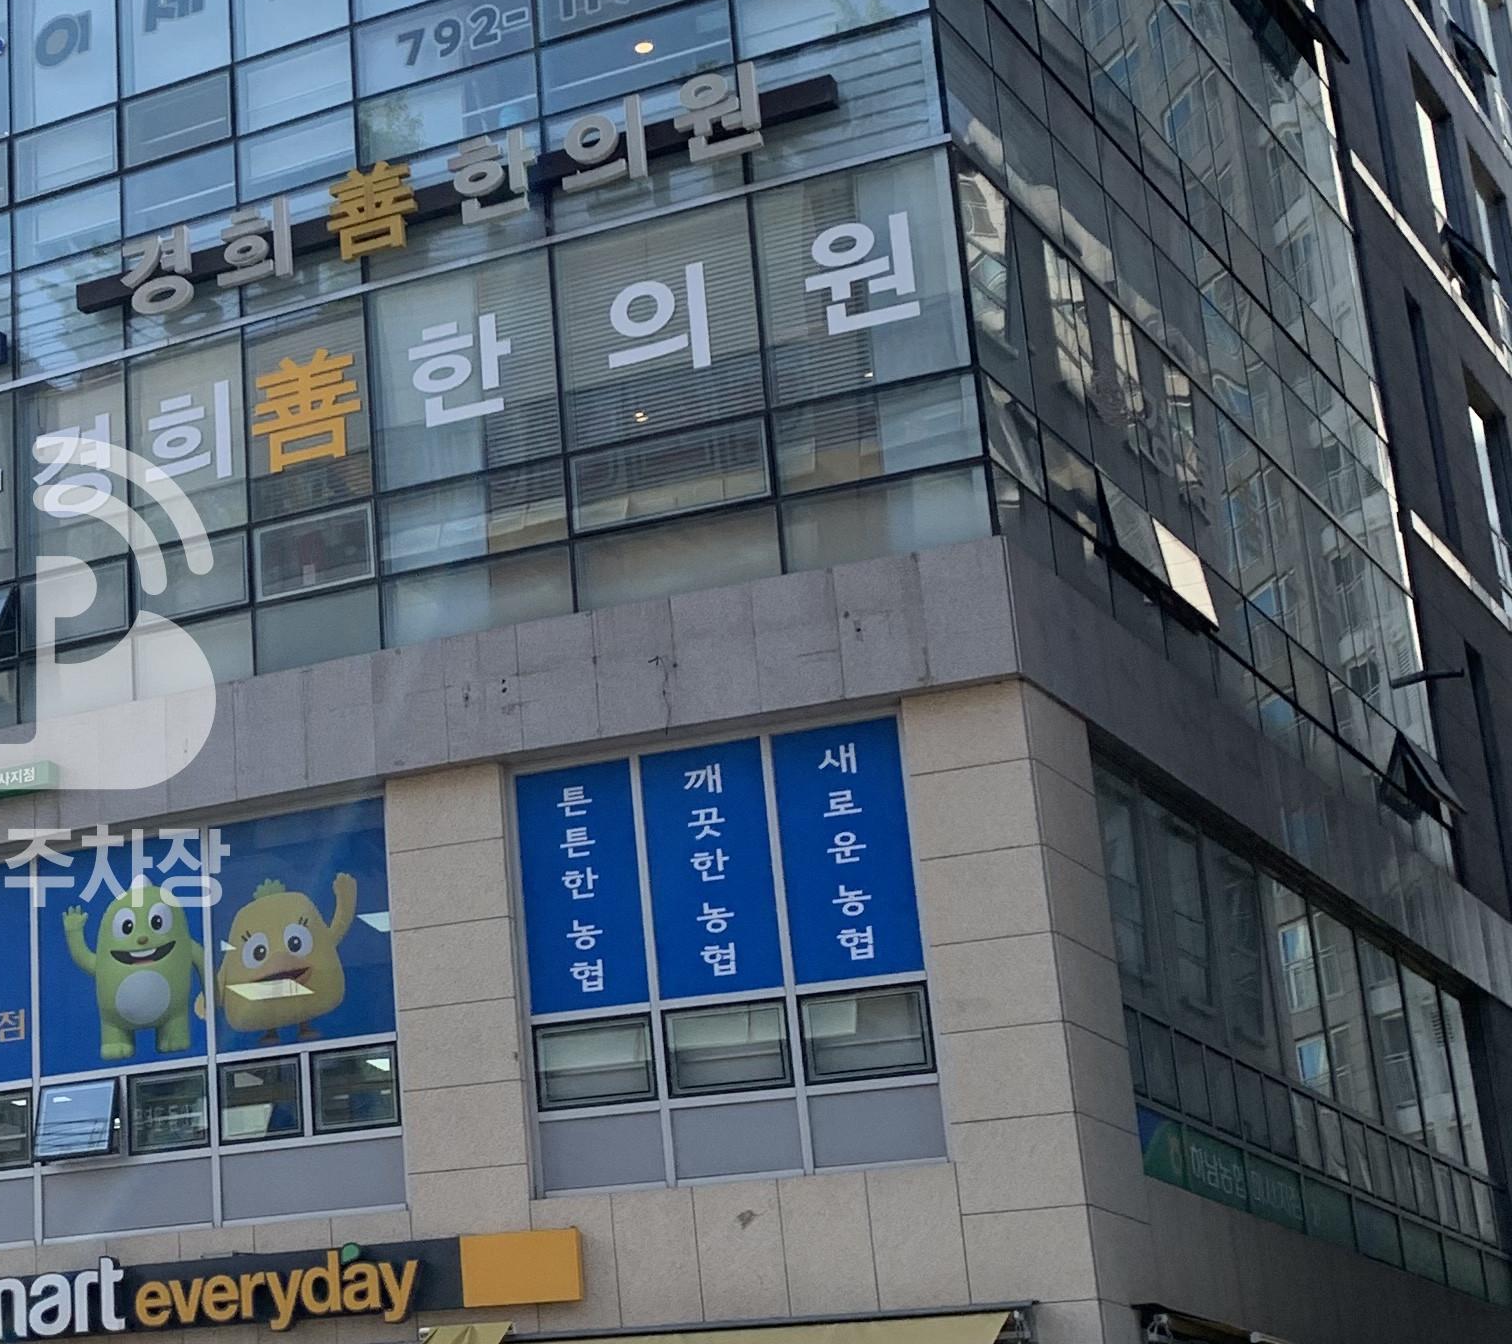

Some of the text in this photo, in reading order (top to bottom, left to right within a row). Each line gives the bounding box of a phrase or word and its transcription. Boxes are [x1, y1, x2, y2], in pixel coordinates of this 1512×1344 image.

[556, 784, 605, 993] 튼튼한 농협
[683, 762, 738, 977] 깨끗한 농협
[817, 741, 876, 961] 새로운 농협
[134, 1244, 419, 1333] everyday
